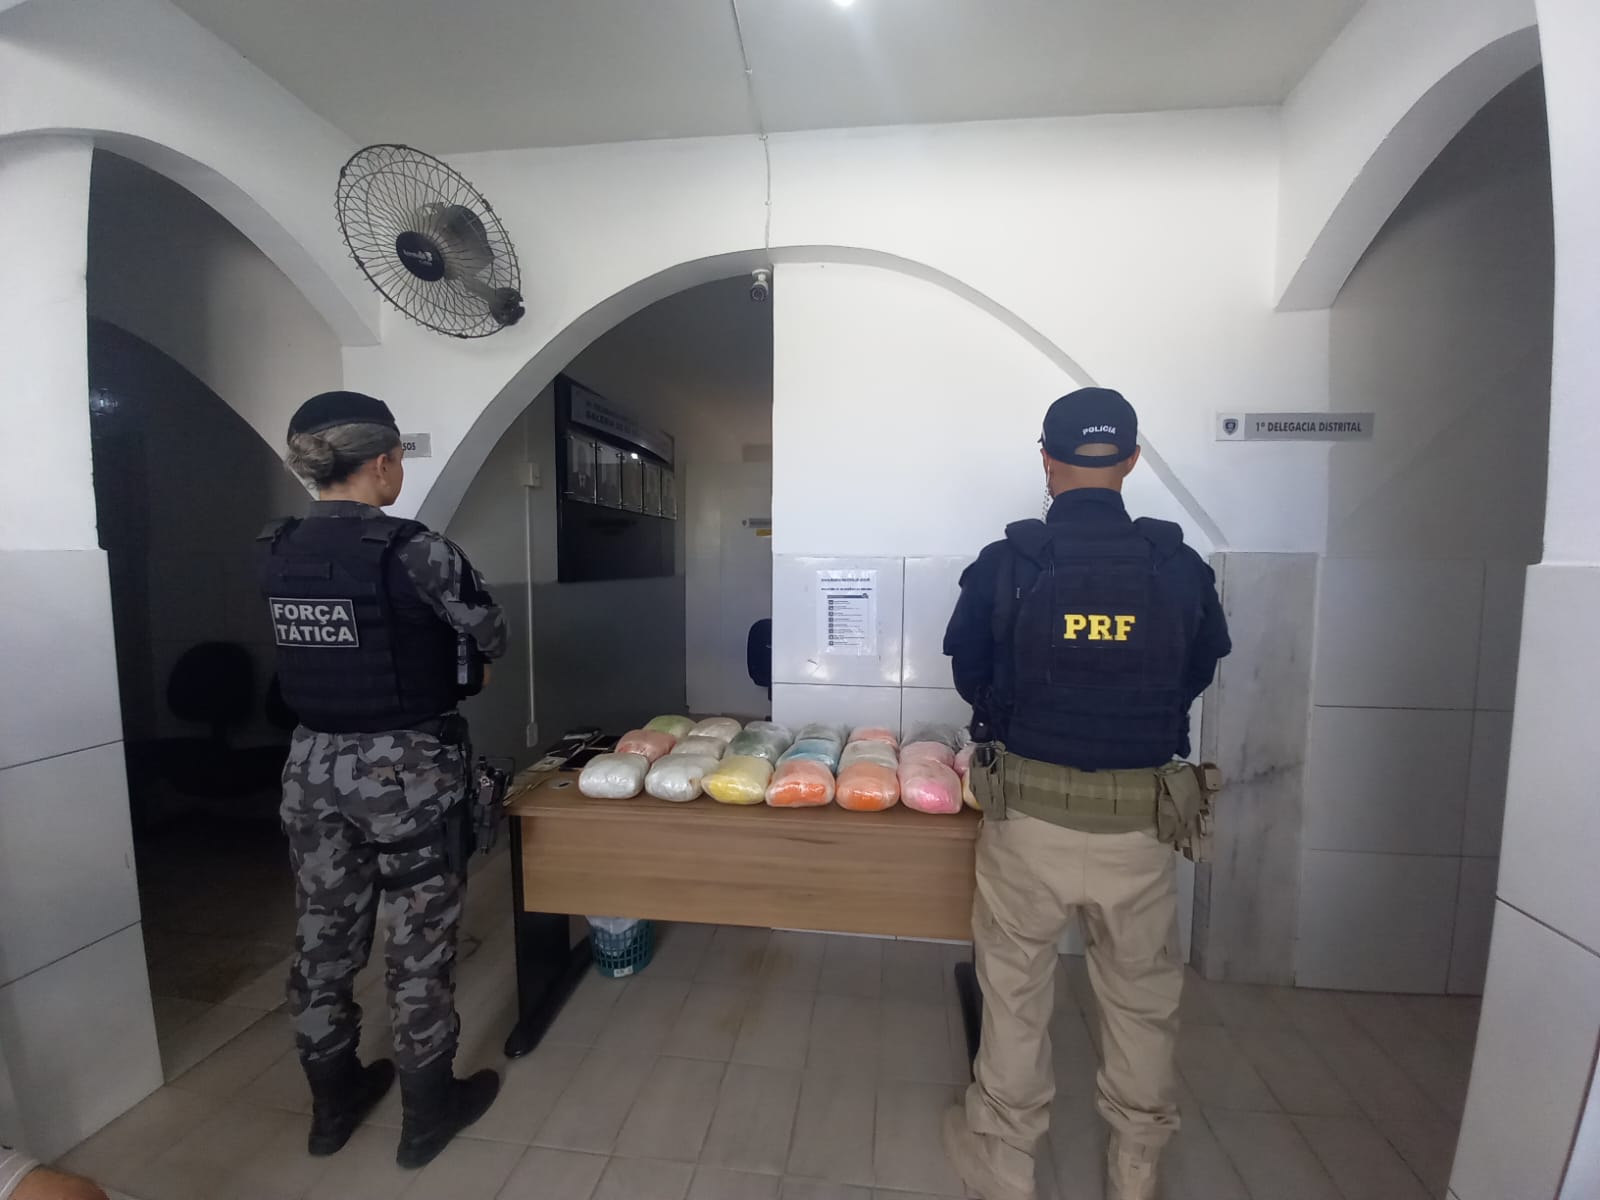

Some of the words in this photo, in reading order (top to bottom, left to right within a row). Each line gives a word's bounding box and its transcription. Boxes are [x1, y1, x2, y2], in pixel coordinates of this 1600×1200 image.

[1267, 422, 1316, 432] DELEGACIA
[1318, 422, 1361, 432] DISTRITAL
[273, 604, 348, 624] FORÇA
[277, 622, 353, 642] TÁTICA
[1063, 614, 1136, 640] PRF
